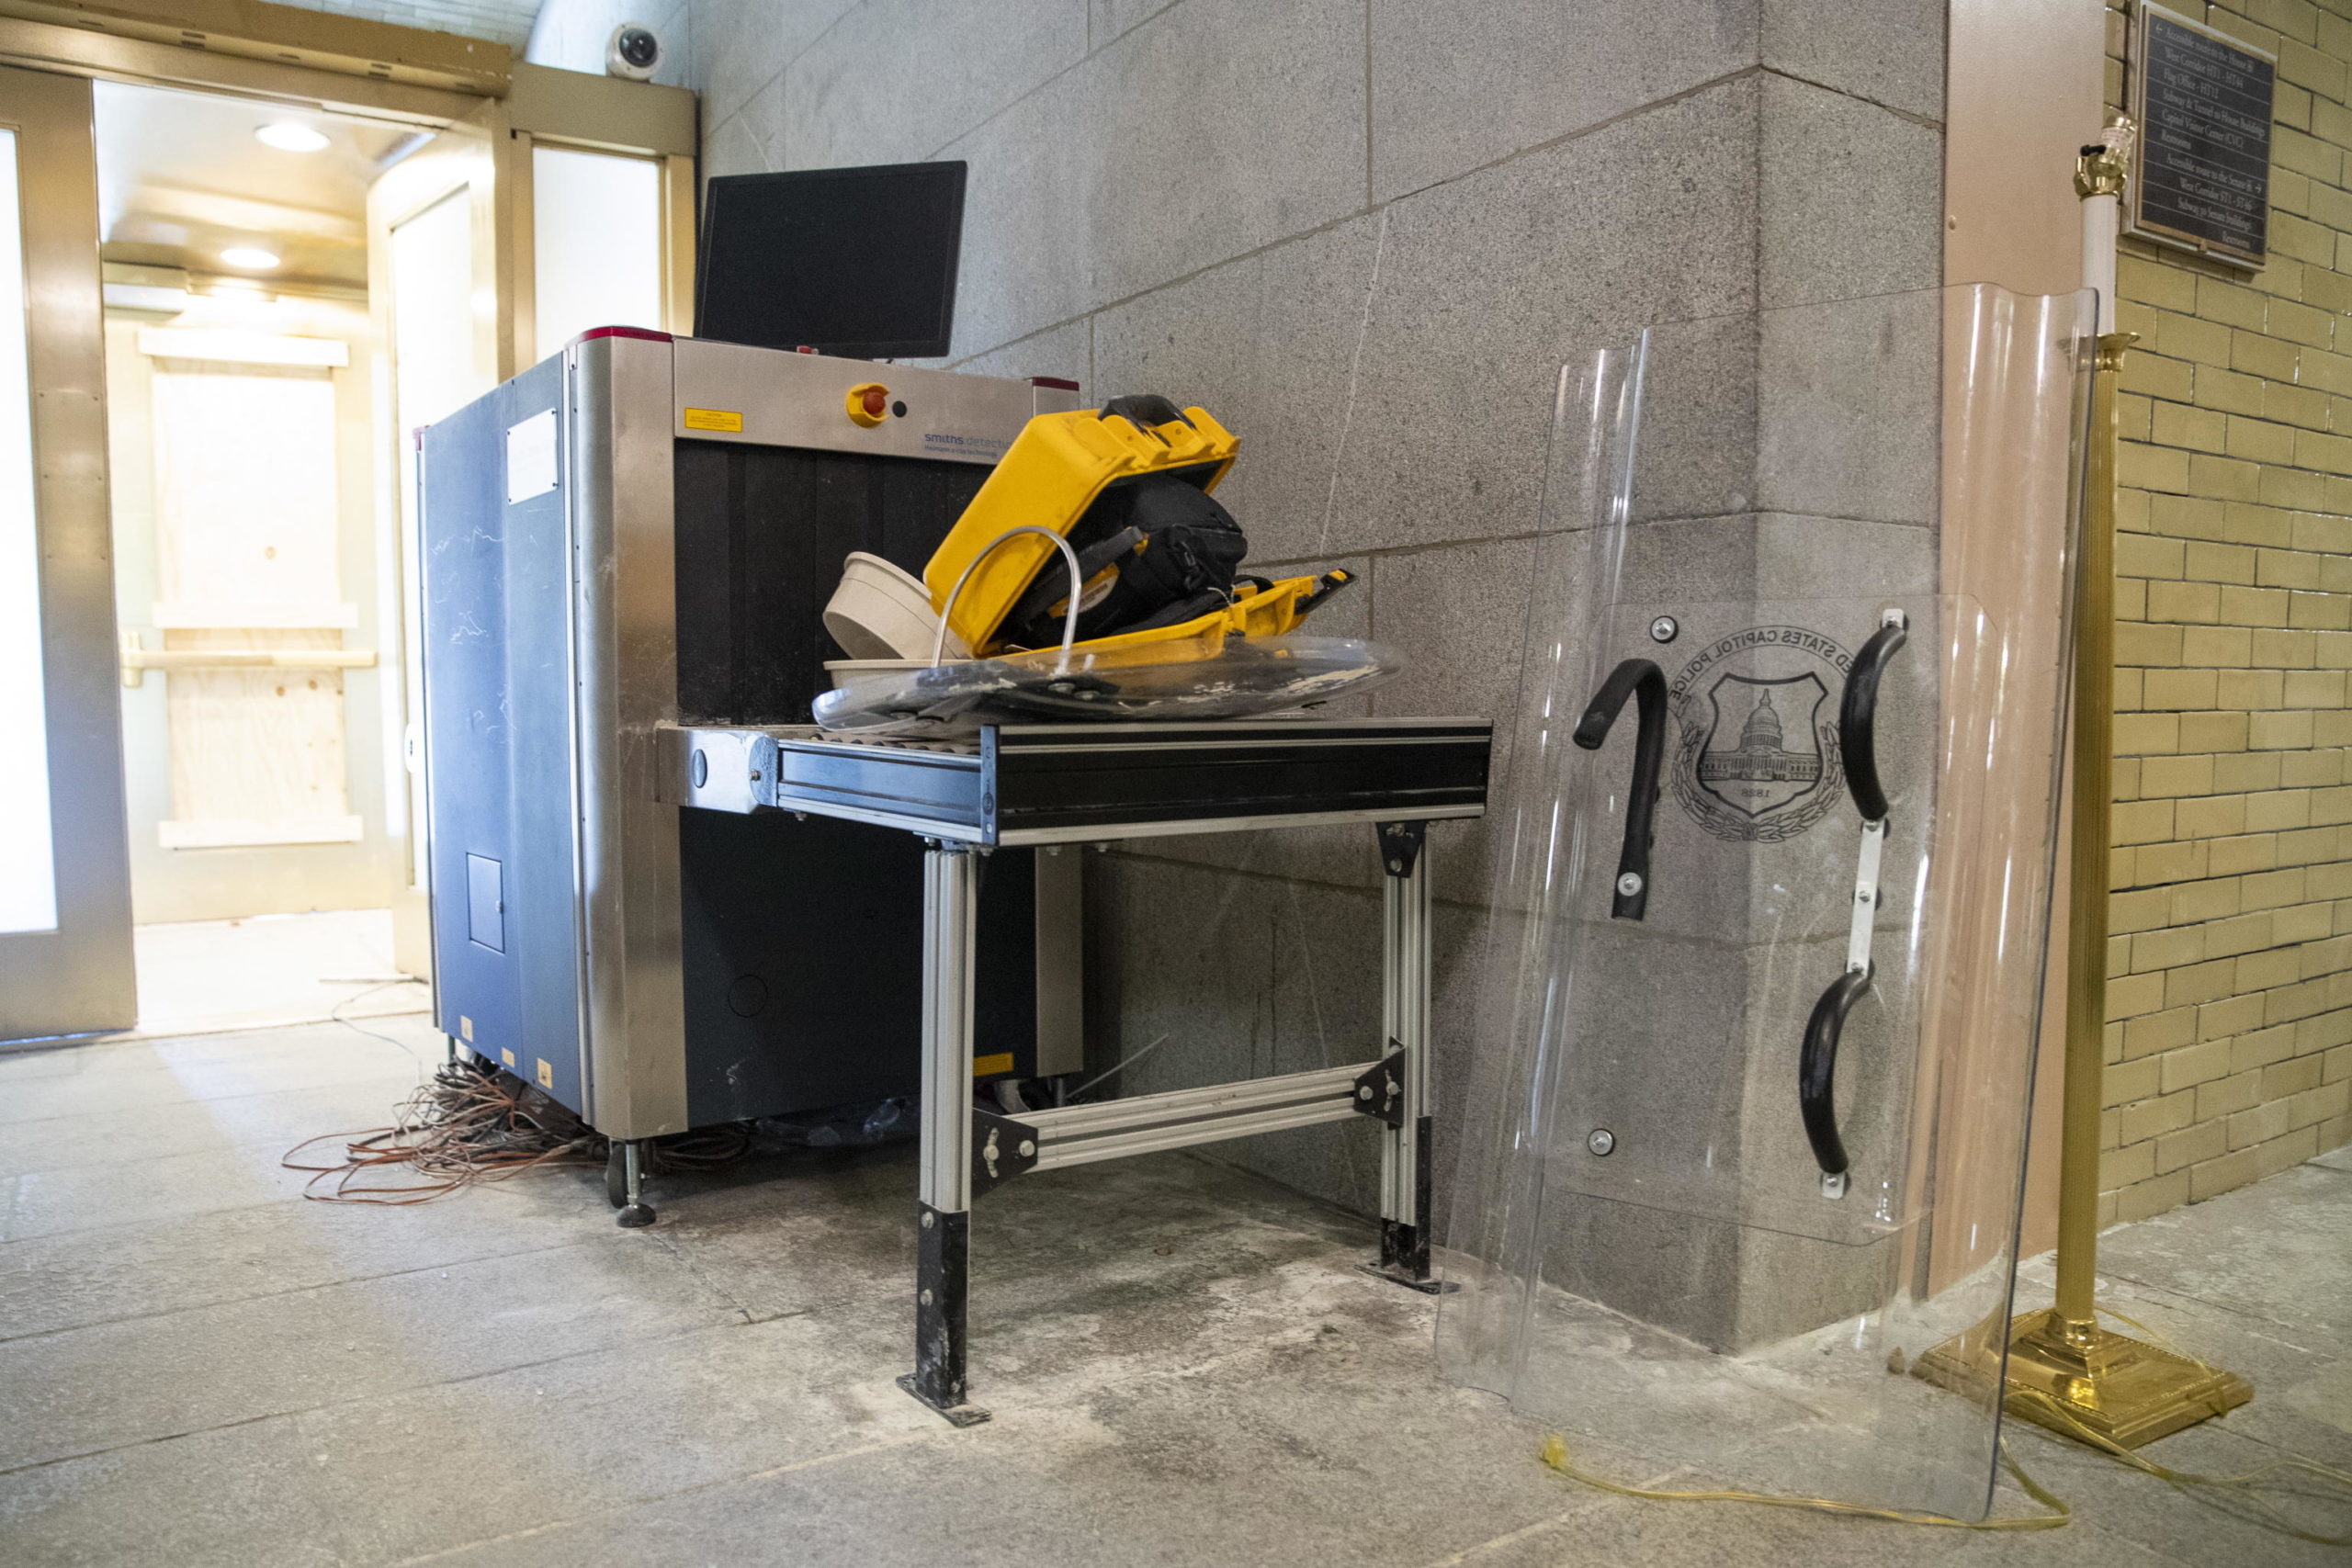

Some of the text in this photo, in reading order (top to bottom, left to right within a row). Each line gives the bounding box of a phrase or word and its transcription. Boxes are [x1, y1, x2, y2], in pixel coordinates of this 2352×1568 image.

[2165, 27, 2195, 48] Accessible
[2229, 51, 2246, 68] House
[2180, 52, 2206, 73] Corridor
[2164, 68, 2177, 86] Flag
[2177, 73, 2196, 90] Office
[2163, 88, 2186, 109] Subway
[2194, 101, 2214, 118] Tunnel
[2205, 124, 2224, 141] Center
[2166, 152, 2195, 173] Accessible
[2177, 196, 2199, 217] Subway
[924, 433, 965, 445] smiths
